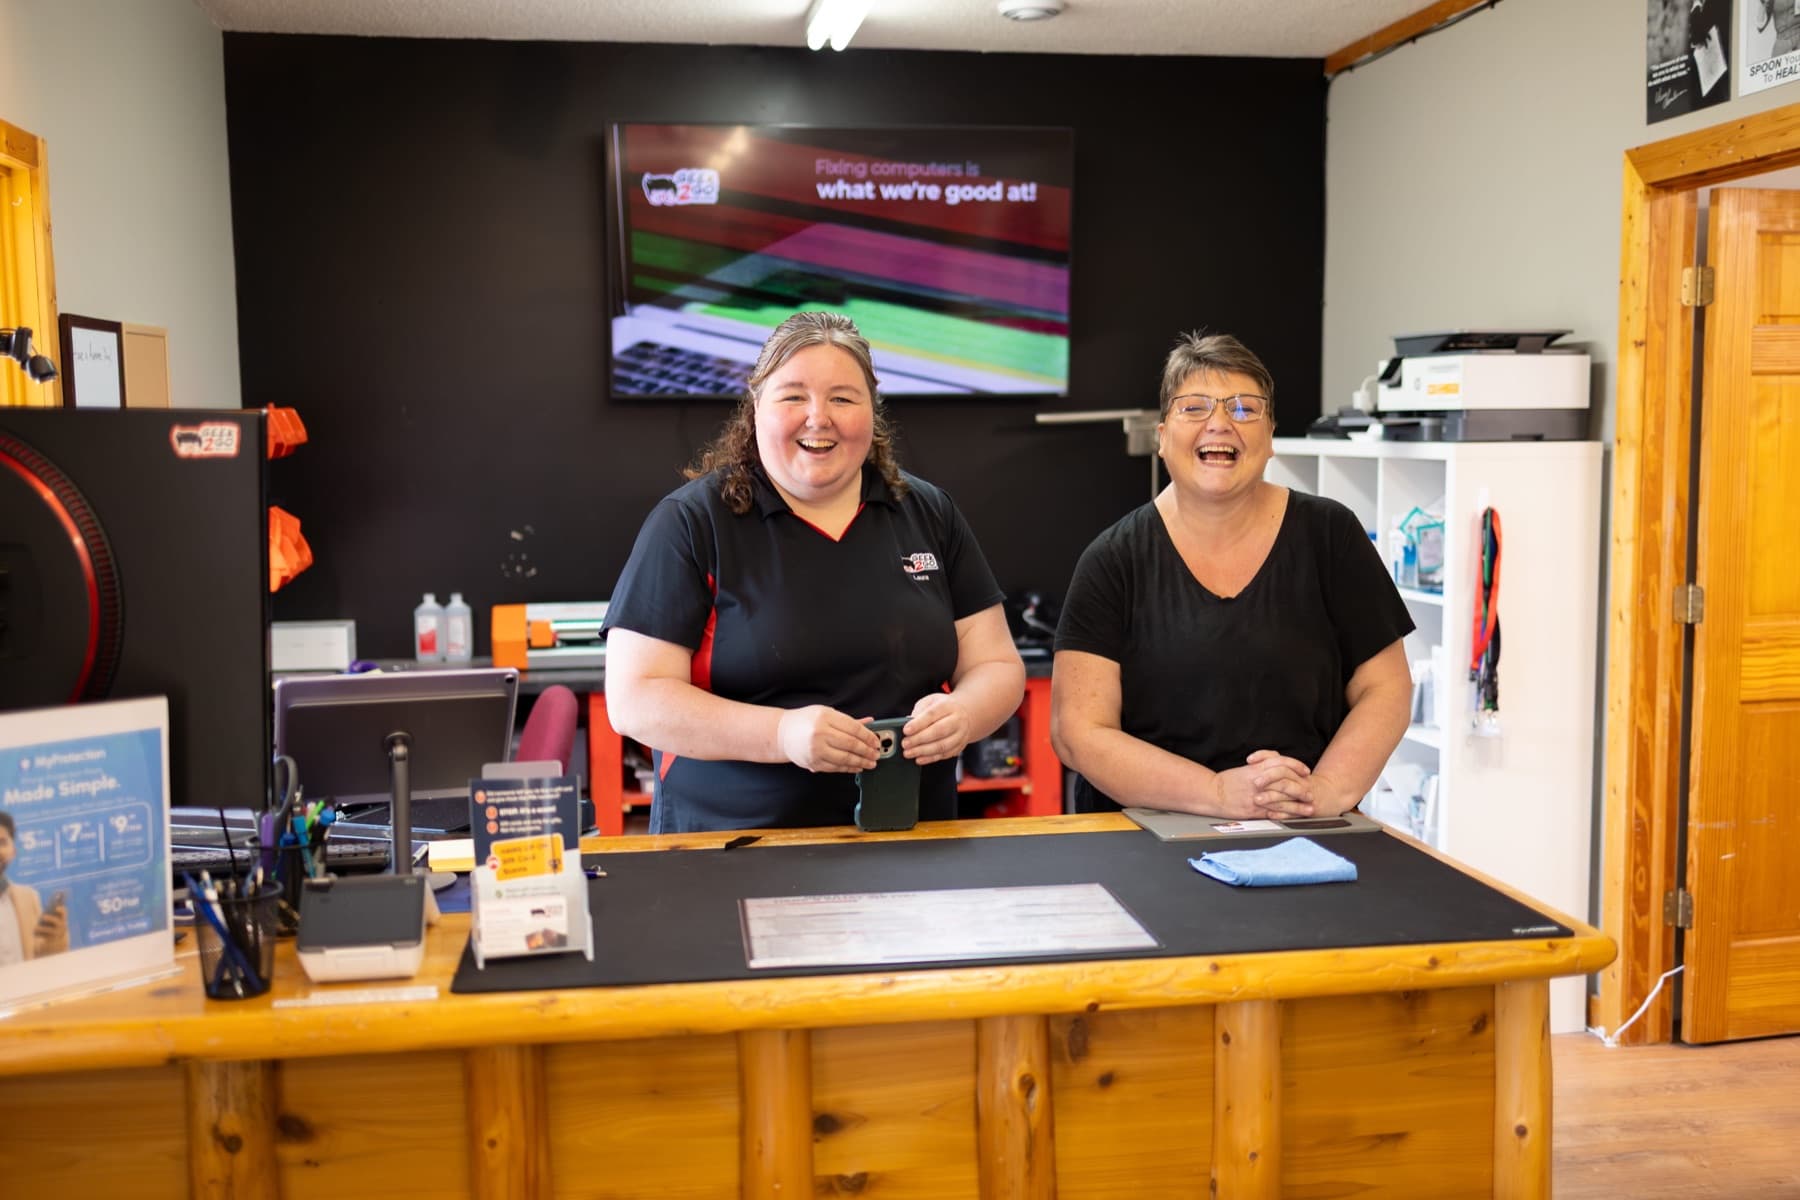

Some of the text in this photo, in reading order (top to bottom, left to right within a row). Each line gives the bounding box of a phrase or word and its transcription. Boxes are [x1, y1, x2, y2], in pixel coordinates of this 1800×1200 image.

[1749, 58, 1782, 77] SPOON
[1775, 62, 1800, 80] HEAL
[815, 158, 981, 179] Fixing computers is
[816, 178, 1038, 206] what we're good at!
[4, 783, 55, 805] Made
